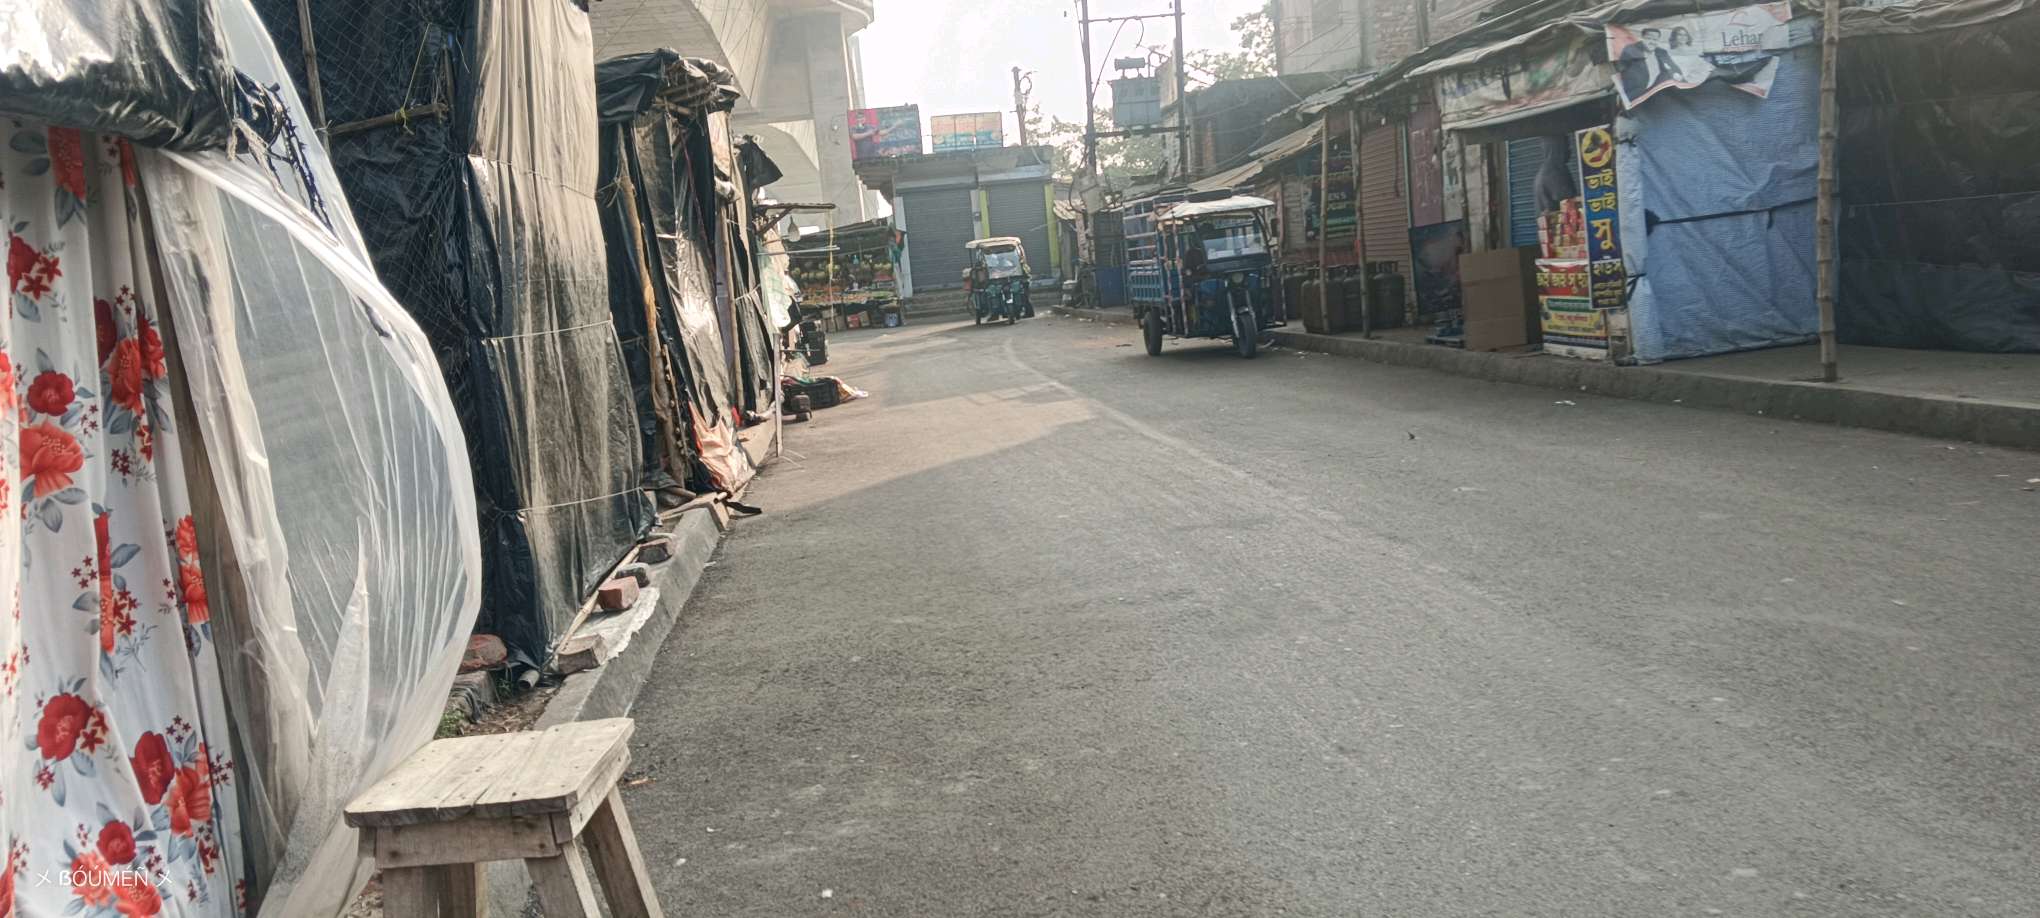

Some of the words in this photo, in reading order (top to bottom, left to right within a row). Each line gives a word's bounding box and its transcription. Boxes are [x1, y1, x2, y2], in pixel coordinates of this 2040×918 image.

[1721, 28, 1763, 47] Lehar
[1584, 168, 1614, 189] ভাই
[1586, 192, 1616, 212] ভাই
[1590, 218, 1617, 250] সু
